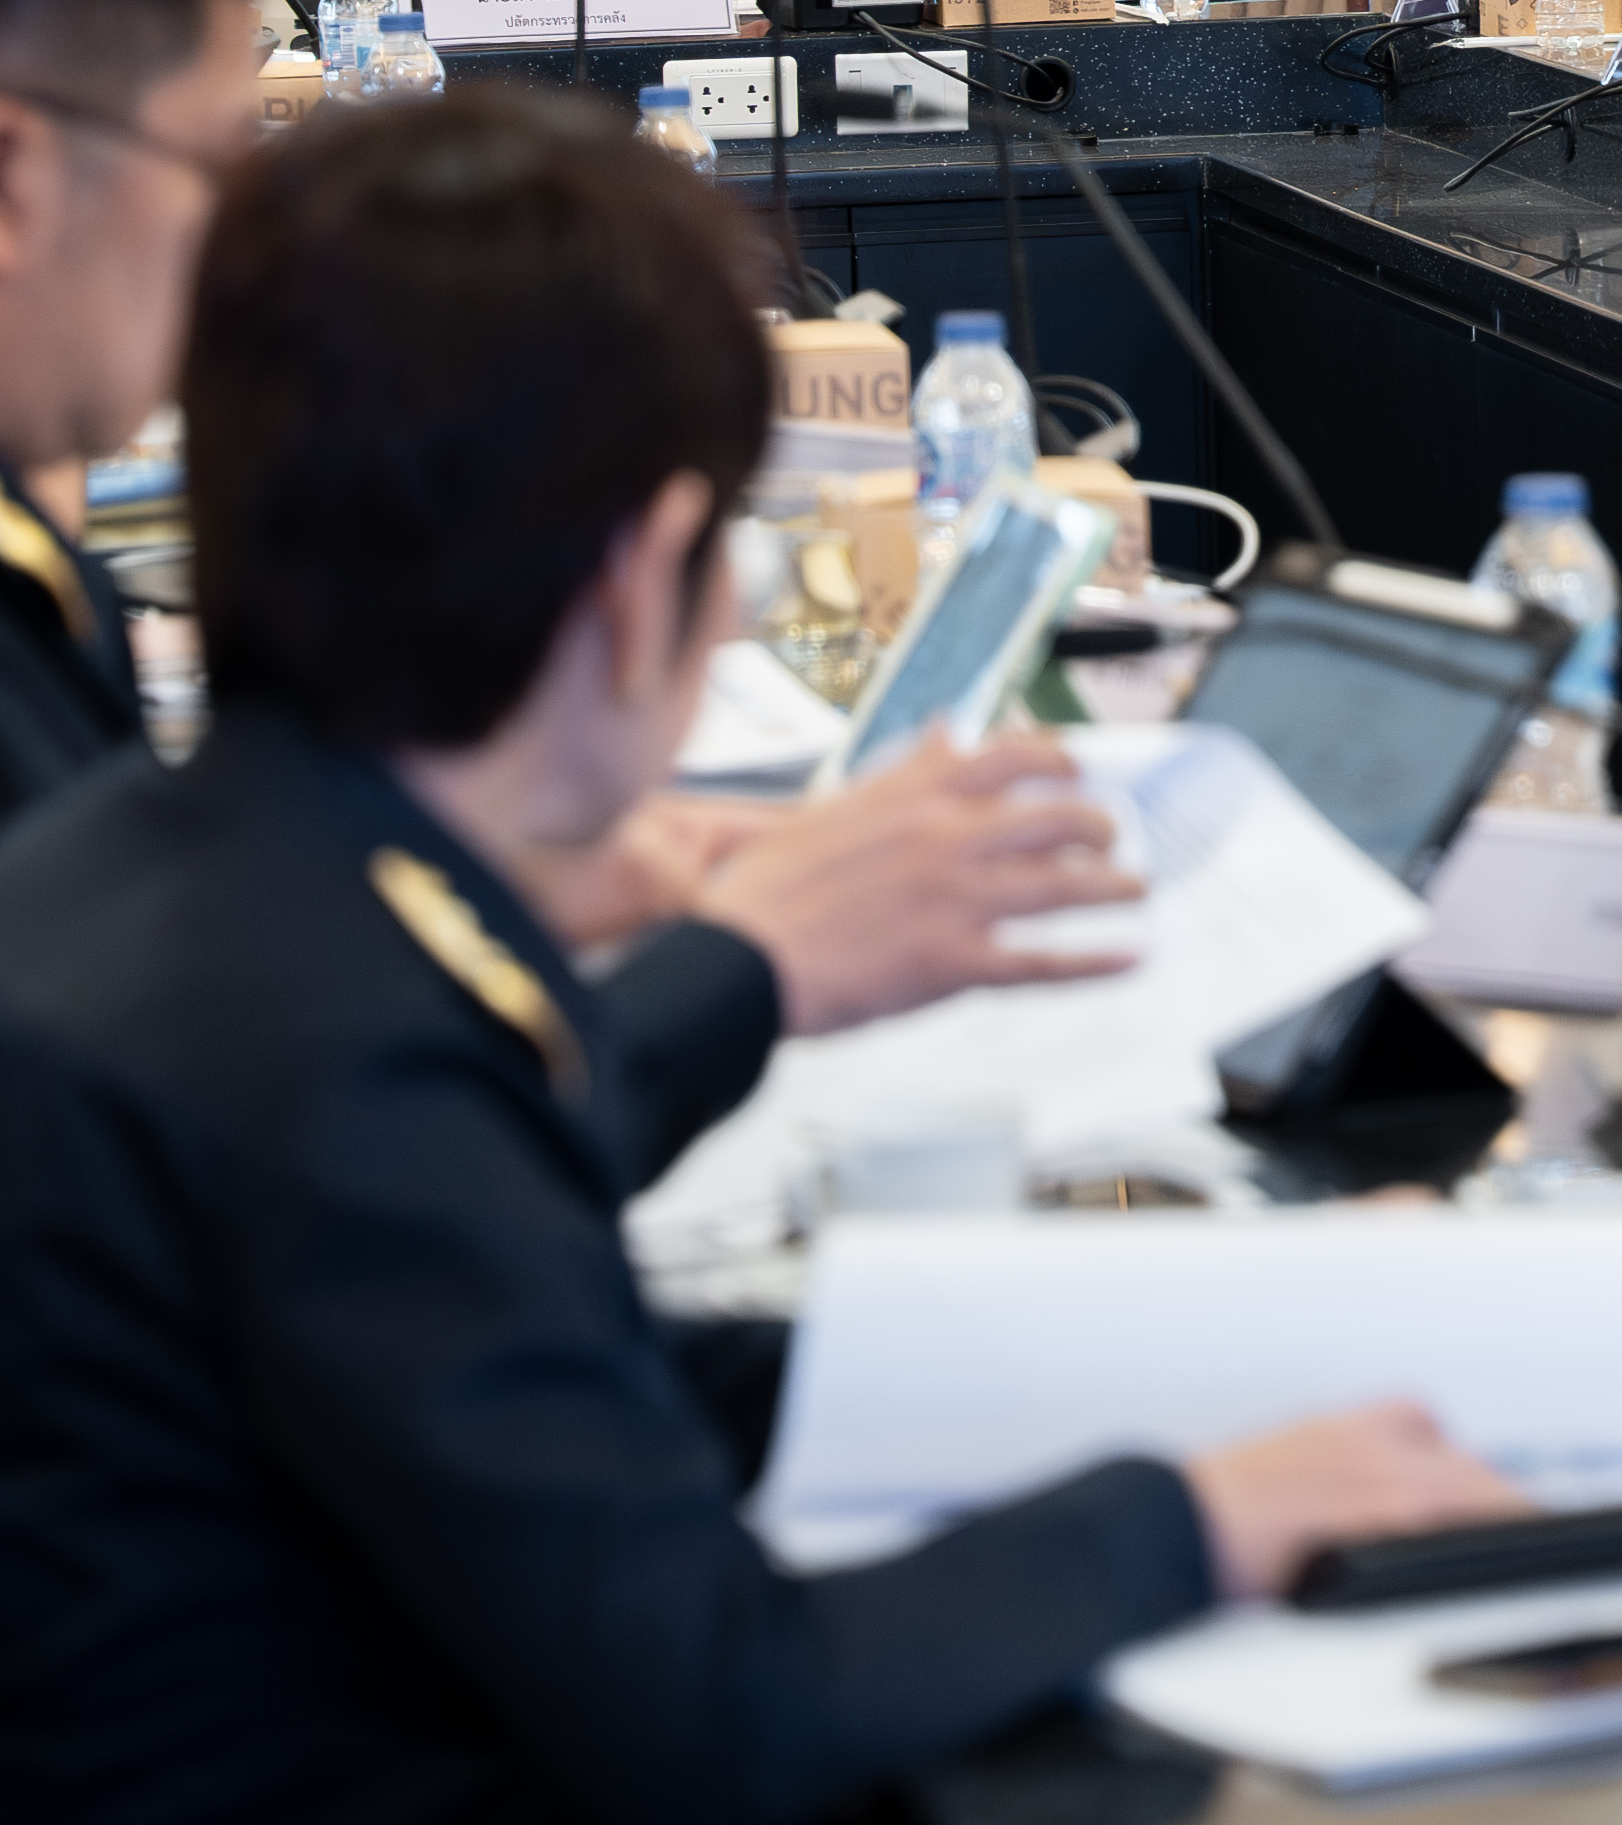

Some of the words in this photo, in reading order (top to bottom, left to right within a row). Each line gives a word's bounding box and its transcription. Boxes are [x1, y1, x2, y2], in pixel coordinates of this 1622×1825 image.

[504, 10, 627, 29] ปลัดกระทรวการคลัง
